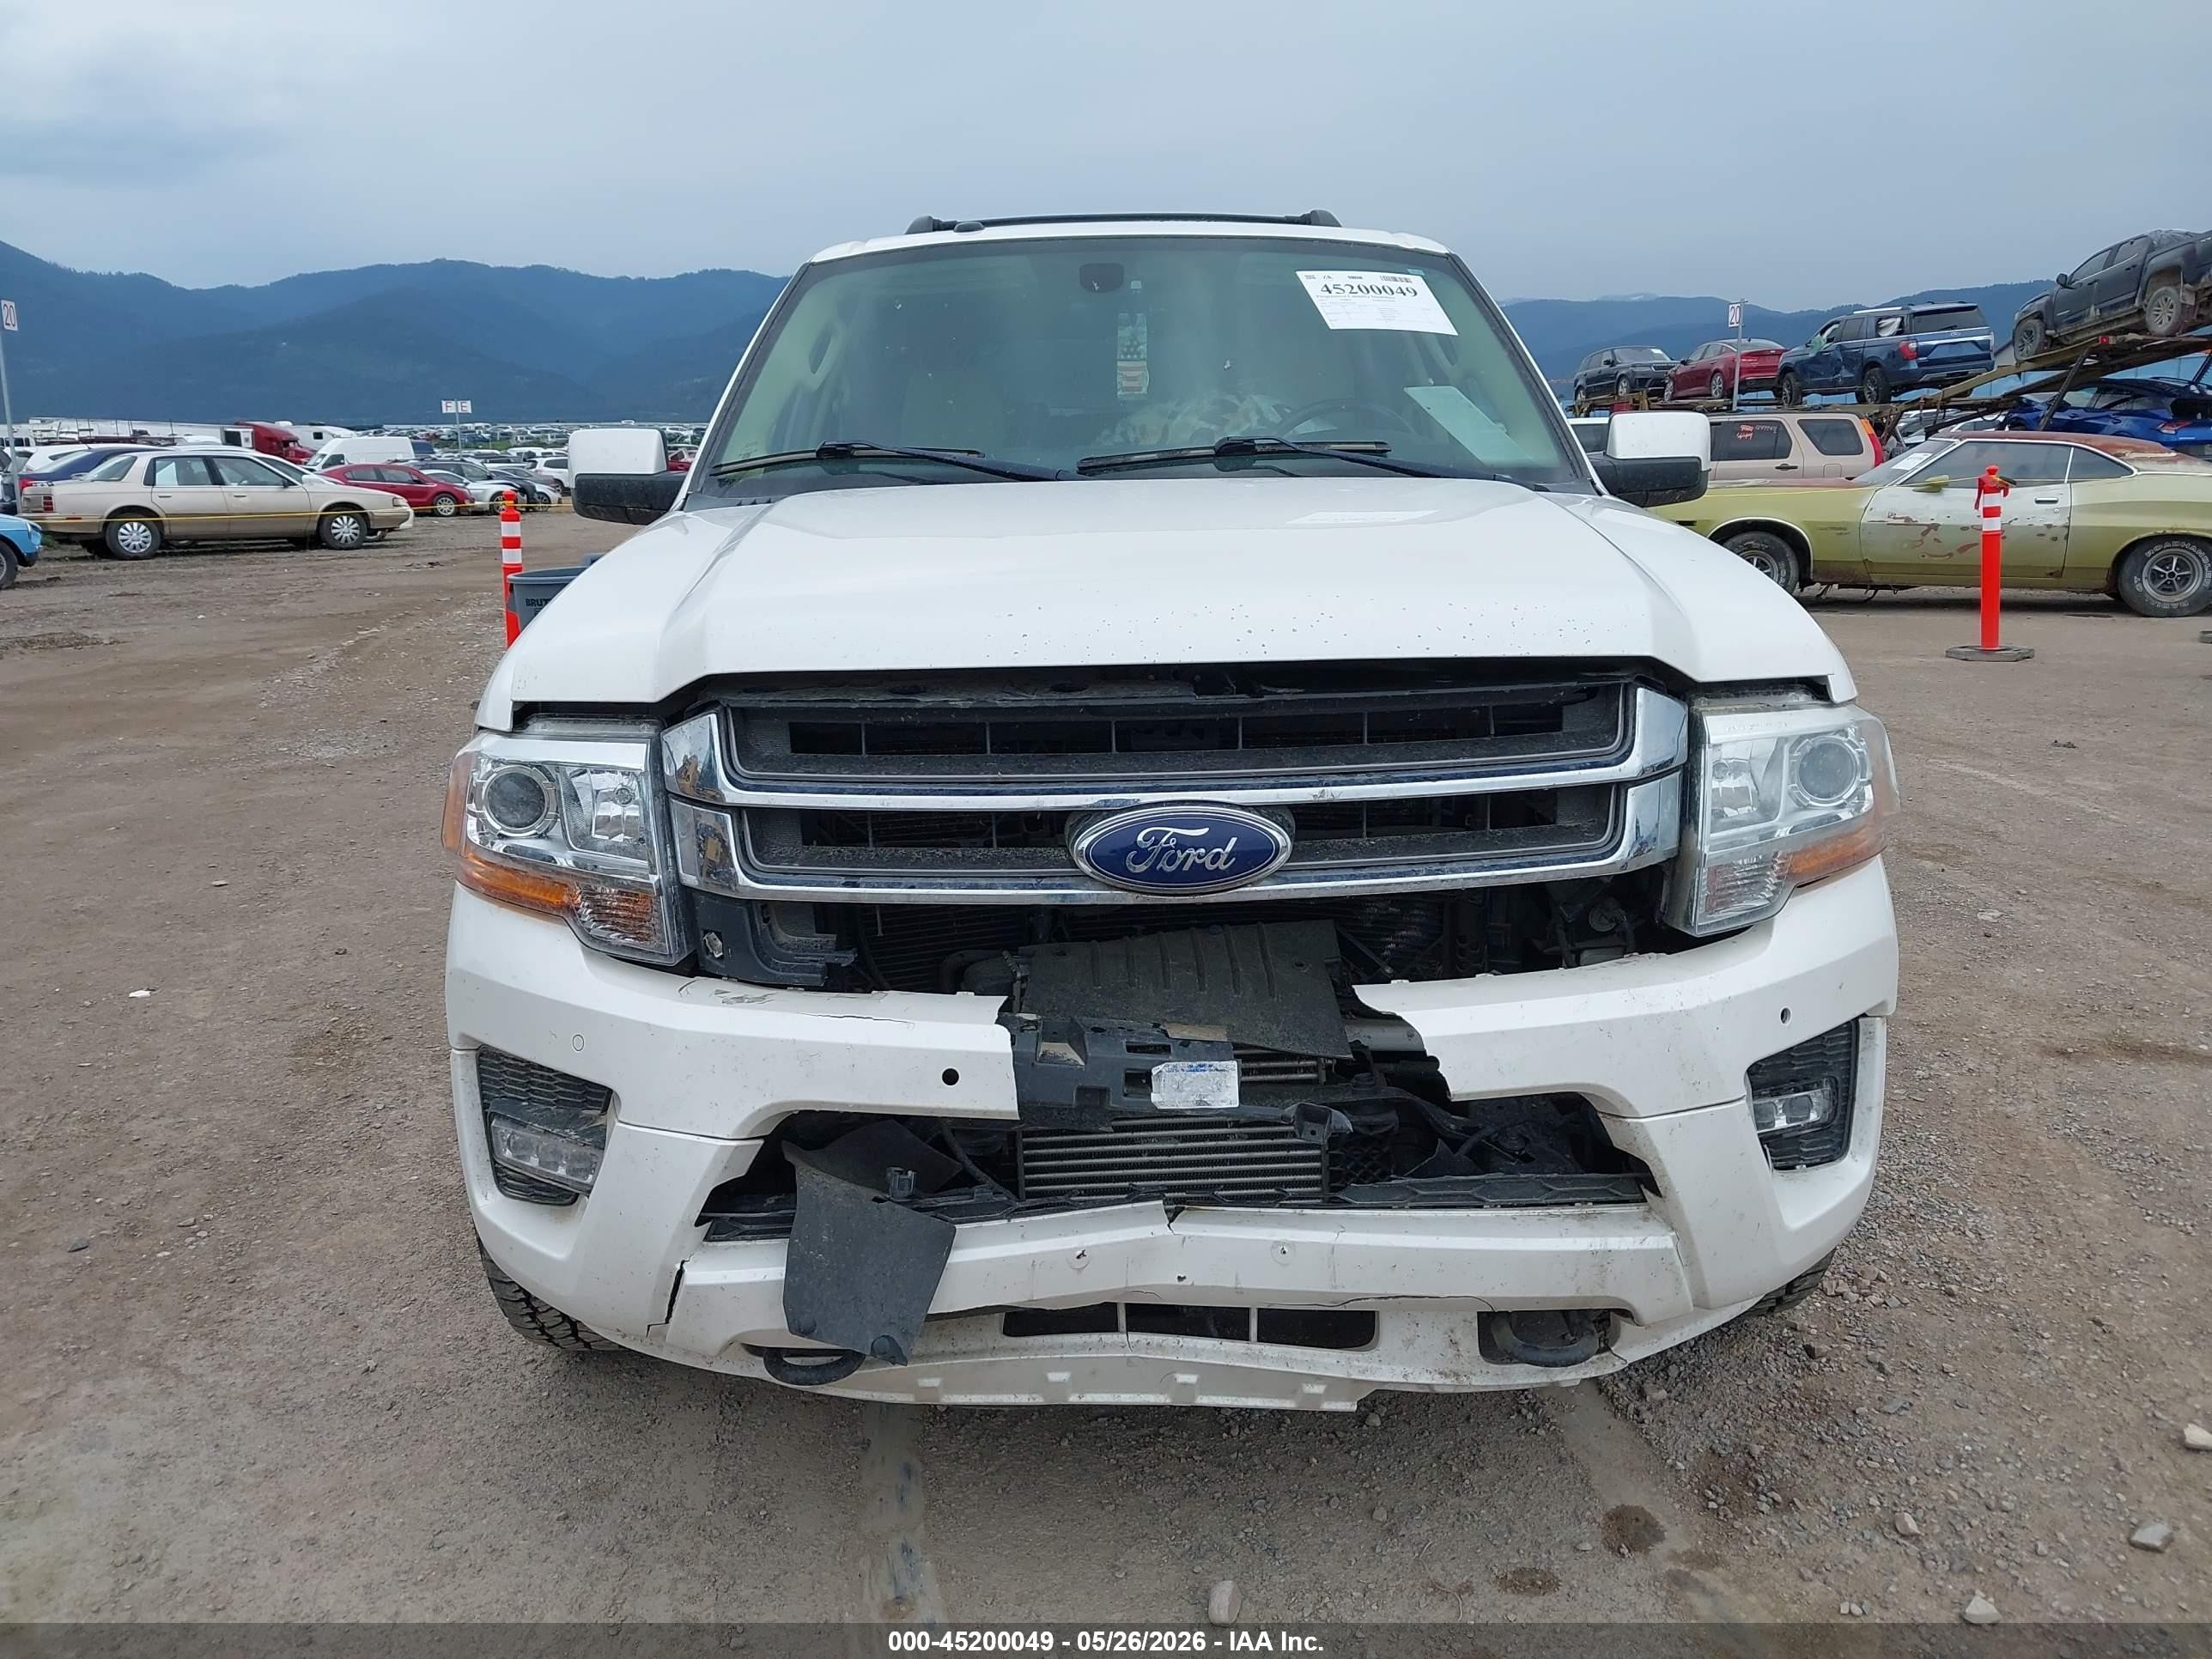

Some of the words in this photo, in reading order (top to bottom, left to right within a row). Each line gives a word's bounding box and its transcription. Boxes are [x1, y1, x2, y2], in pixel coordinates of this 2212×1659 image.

[1321, 283, 1418, 297] 45200049
[3, 303, 16, 327] 20
[1729, 305, 1741, 325] 20
[445, 401, 453, 412] F
[460, 401, 468, 412] E
[1126, 826, 1238, 873] Ford
